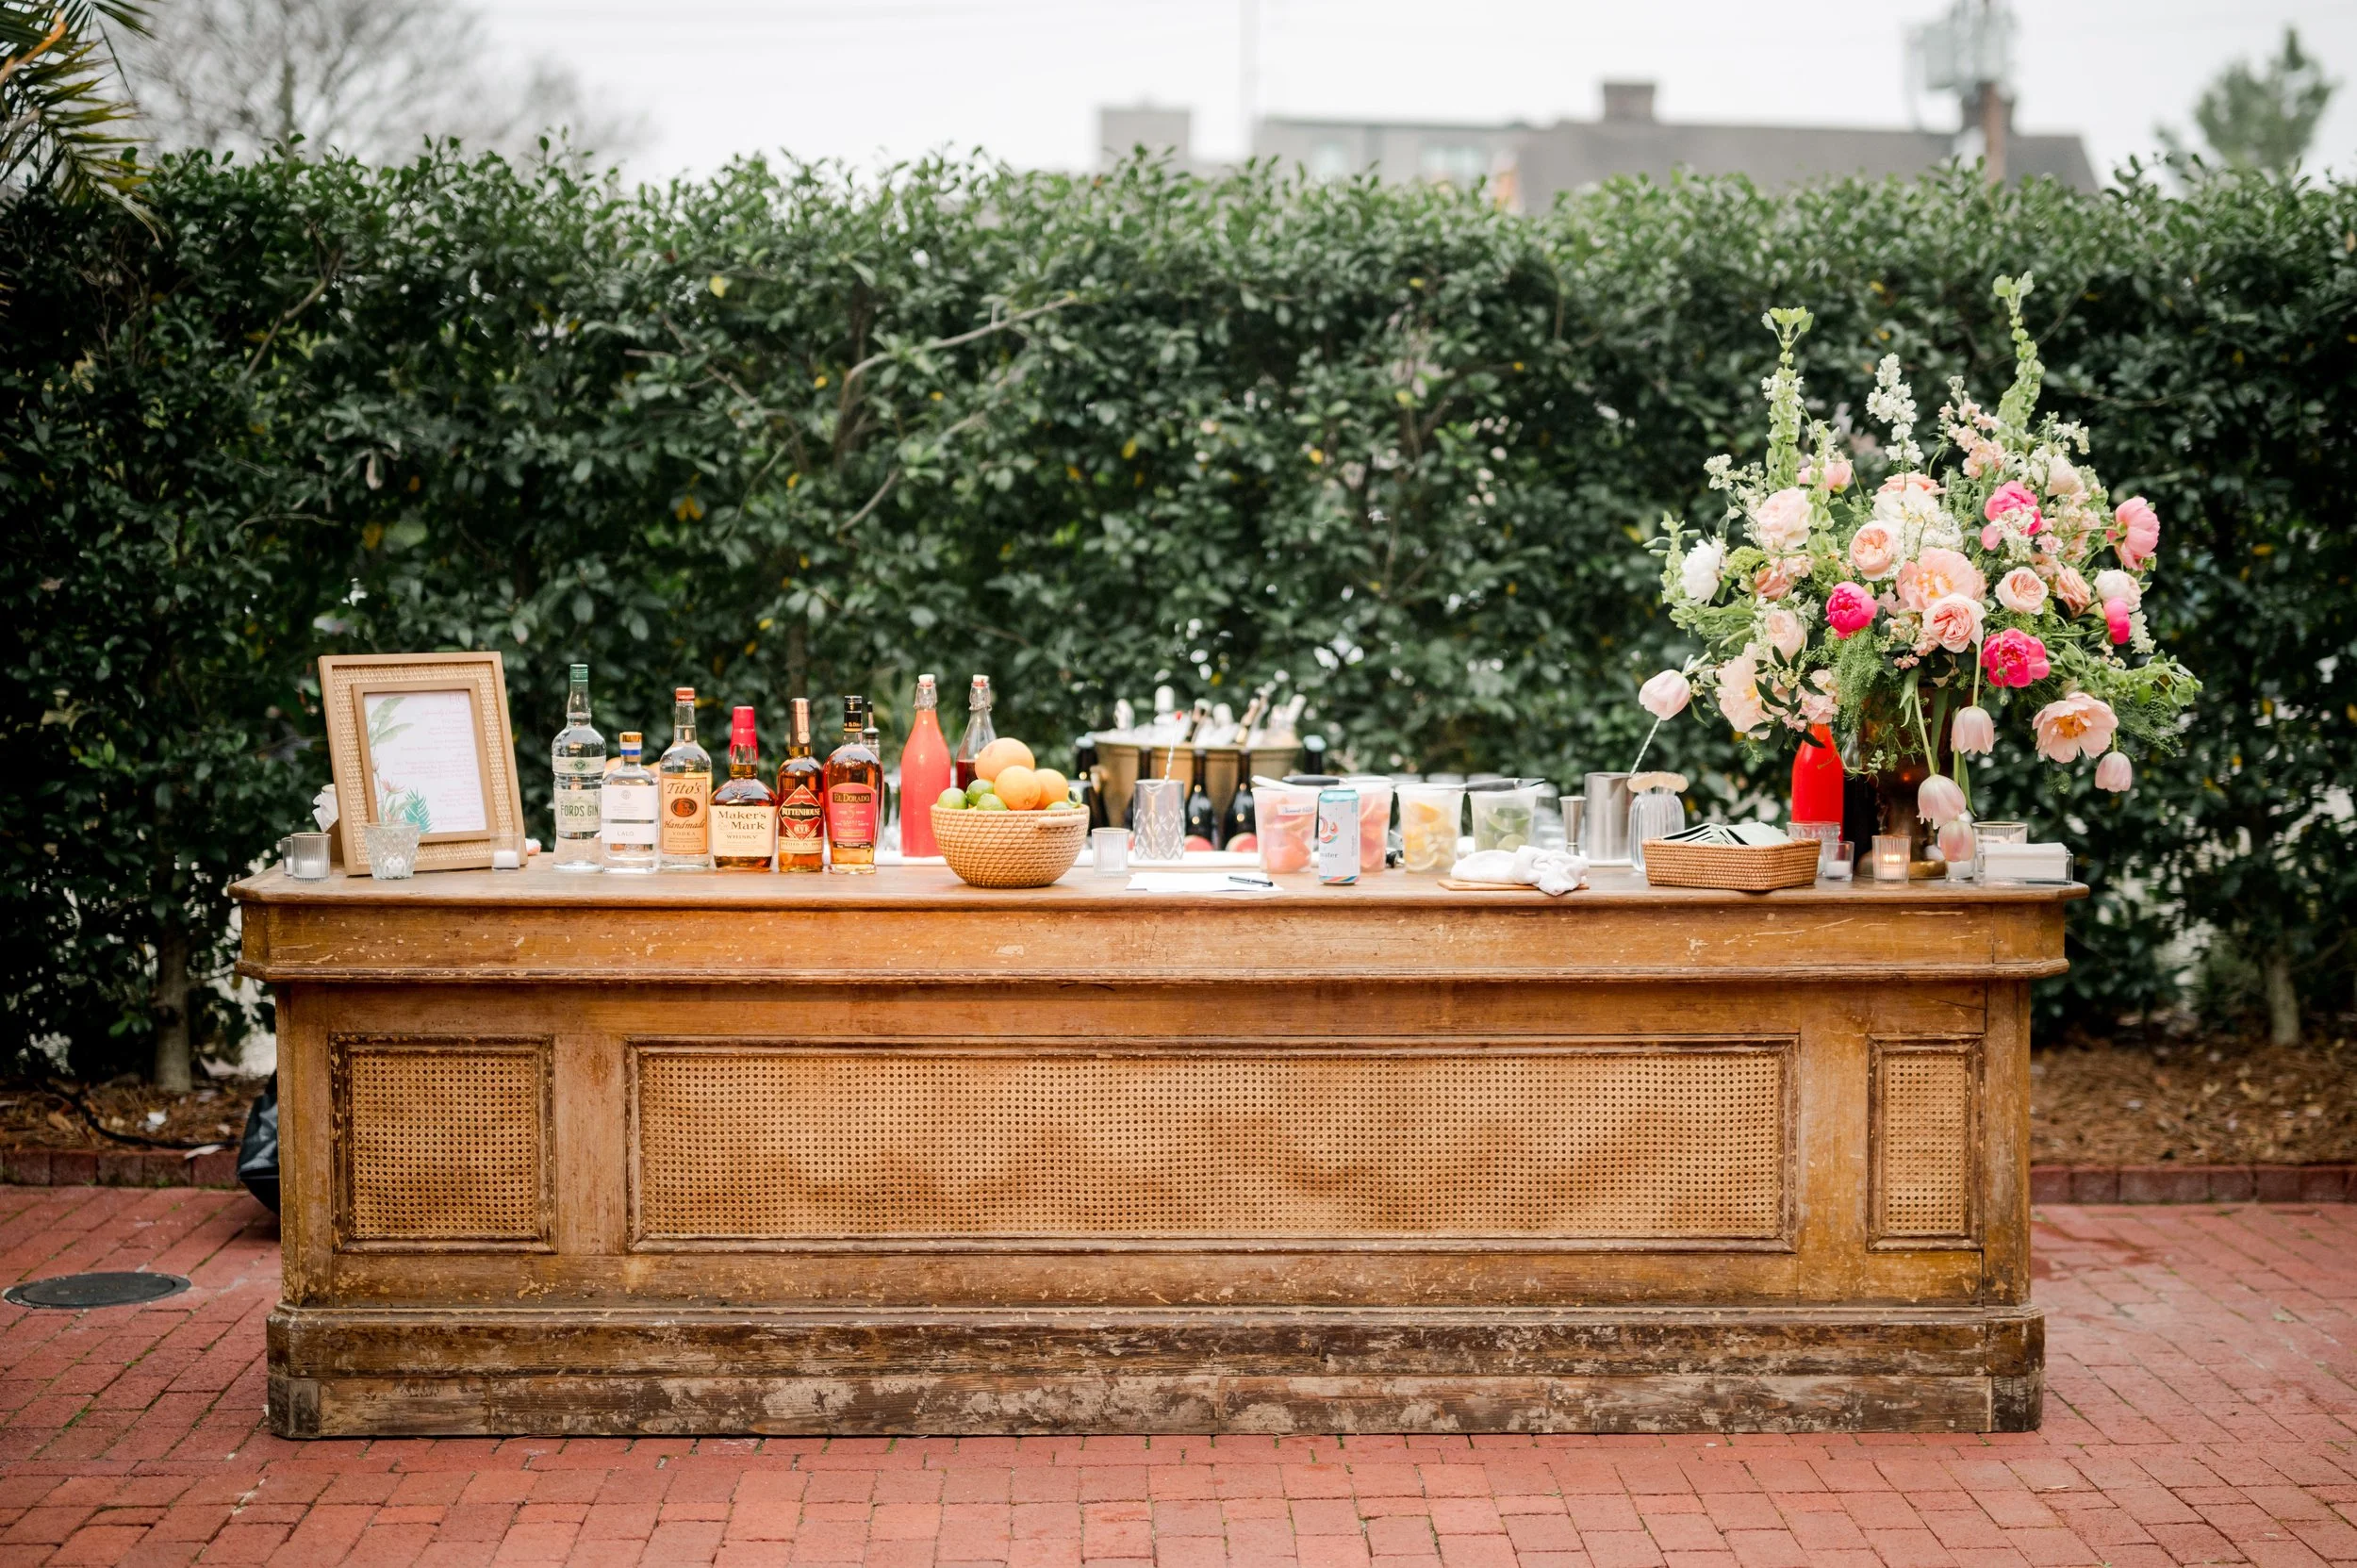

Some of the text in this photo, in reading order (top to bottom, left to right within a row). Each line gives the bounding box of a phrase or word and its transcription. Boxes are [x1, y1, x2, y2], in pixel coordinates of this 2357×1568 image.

[668, 782, 701, 794] Tito's
[843, 793, 870, 801] DORADO
[561, 803, 585, 817] FORDS
[587, 804, 599, 817] GIN
[782, 808, 820, 817] RITTENHOUSE
[717, 811, 766, 819] Maker's
[664, 818, 705, 829] Handmade
[731, 821, 766, 830] Mark
